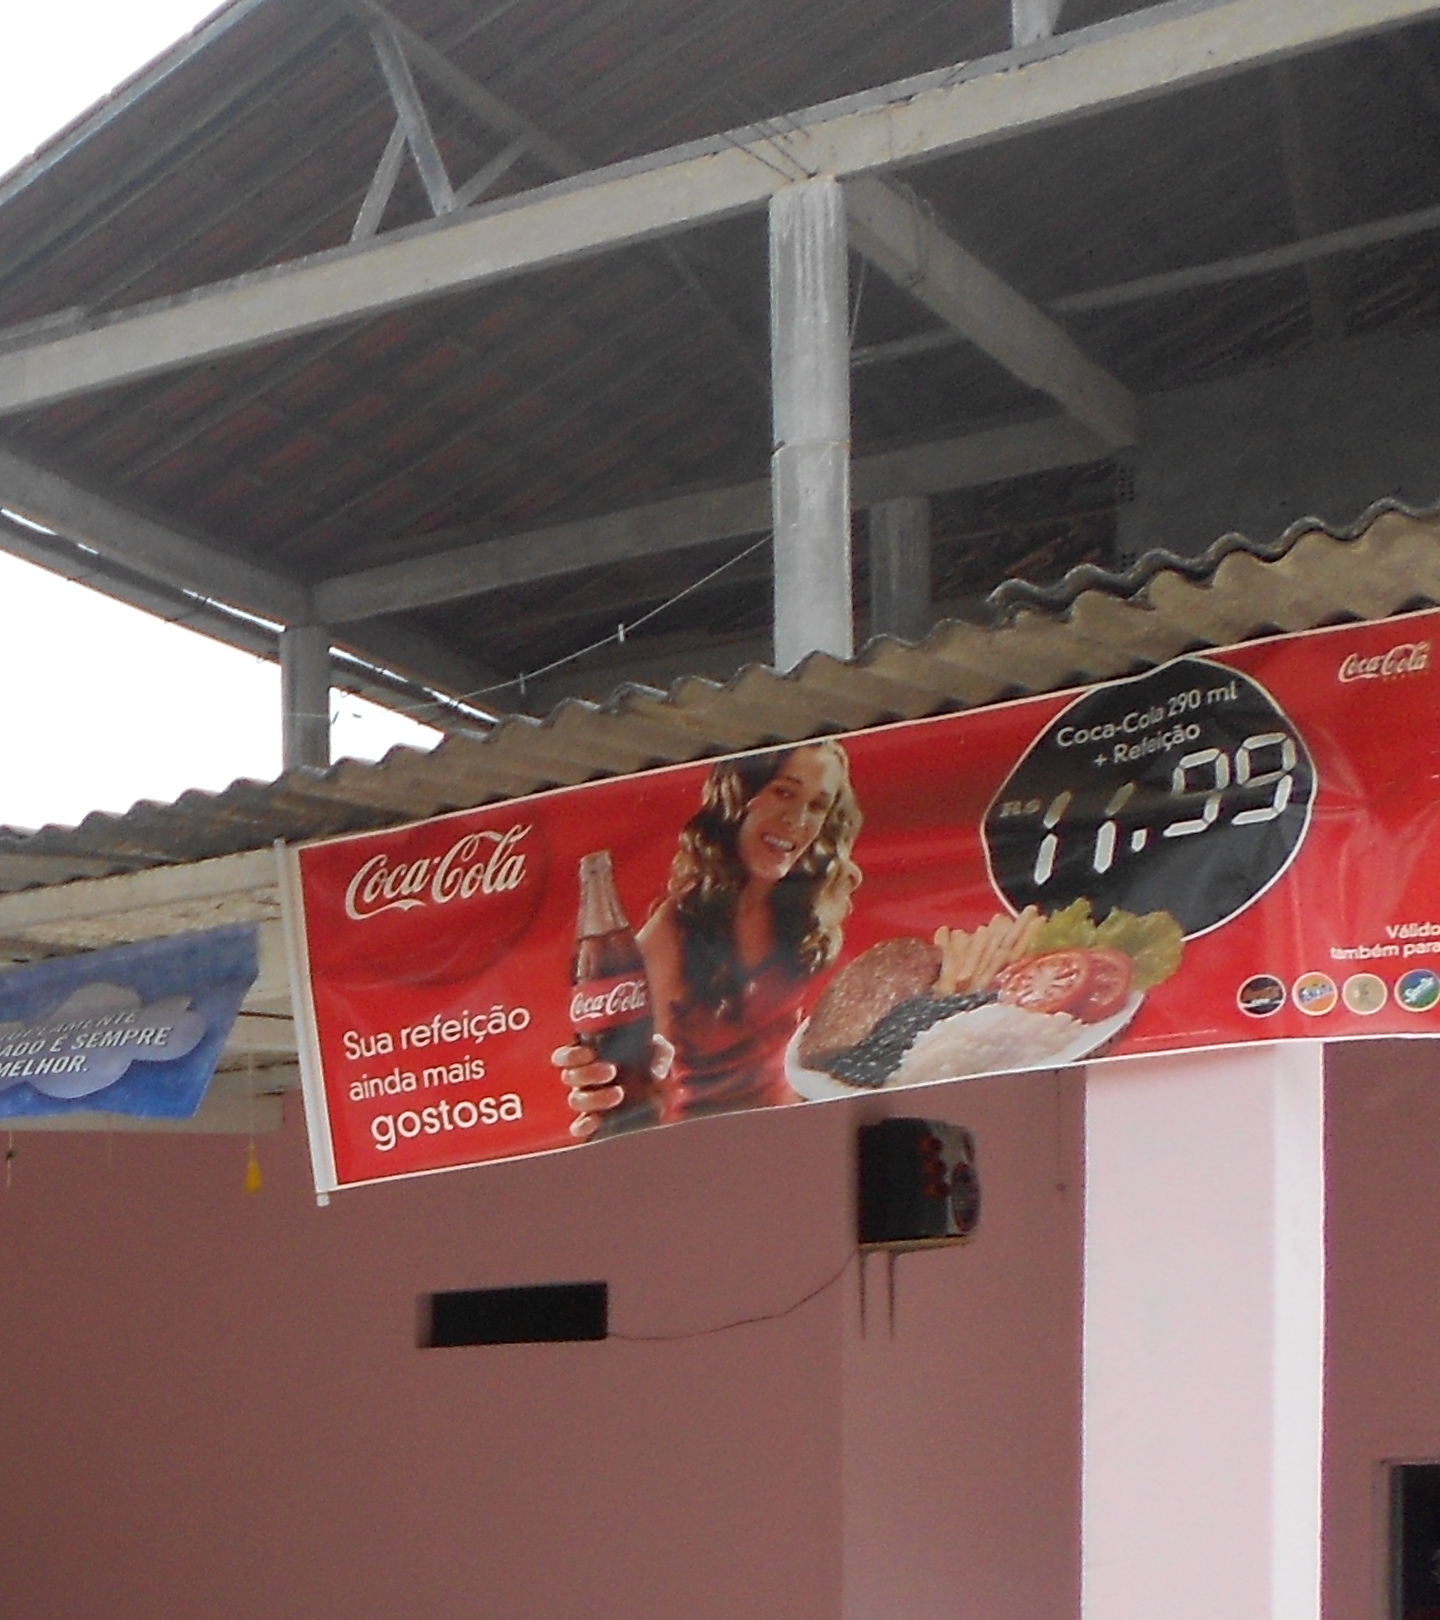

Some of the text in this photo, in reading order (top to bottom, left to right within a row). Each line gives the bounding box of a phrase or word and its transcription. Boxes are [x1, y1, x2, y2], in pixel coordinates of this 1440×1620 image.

[1056, 680, 1239, 748] Coca-Cola 290 ml
[1113, 721, 1201, 764] Refeição
[345, 824, 532, 921] Coca-Cola
[1330, 941, 1440, 961] também para
[1385, 922, 1440, 940] Válido
[71, 1026, 173, 1050] SEMPRE
[343, 1004, 531, 1060] Sua refeição
[349, 1055, 486, 1101] ainda mais
[371, 1093, 523, 1152] gostosa
